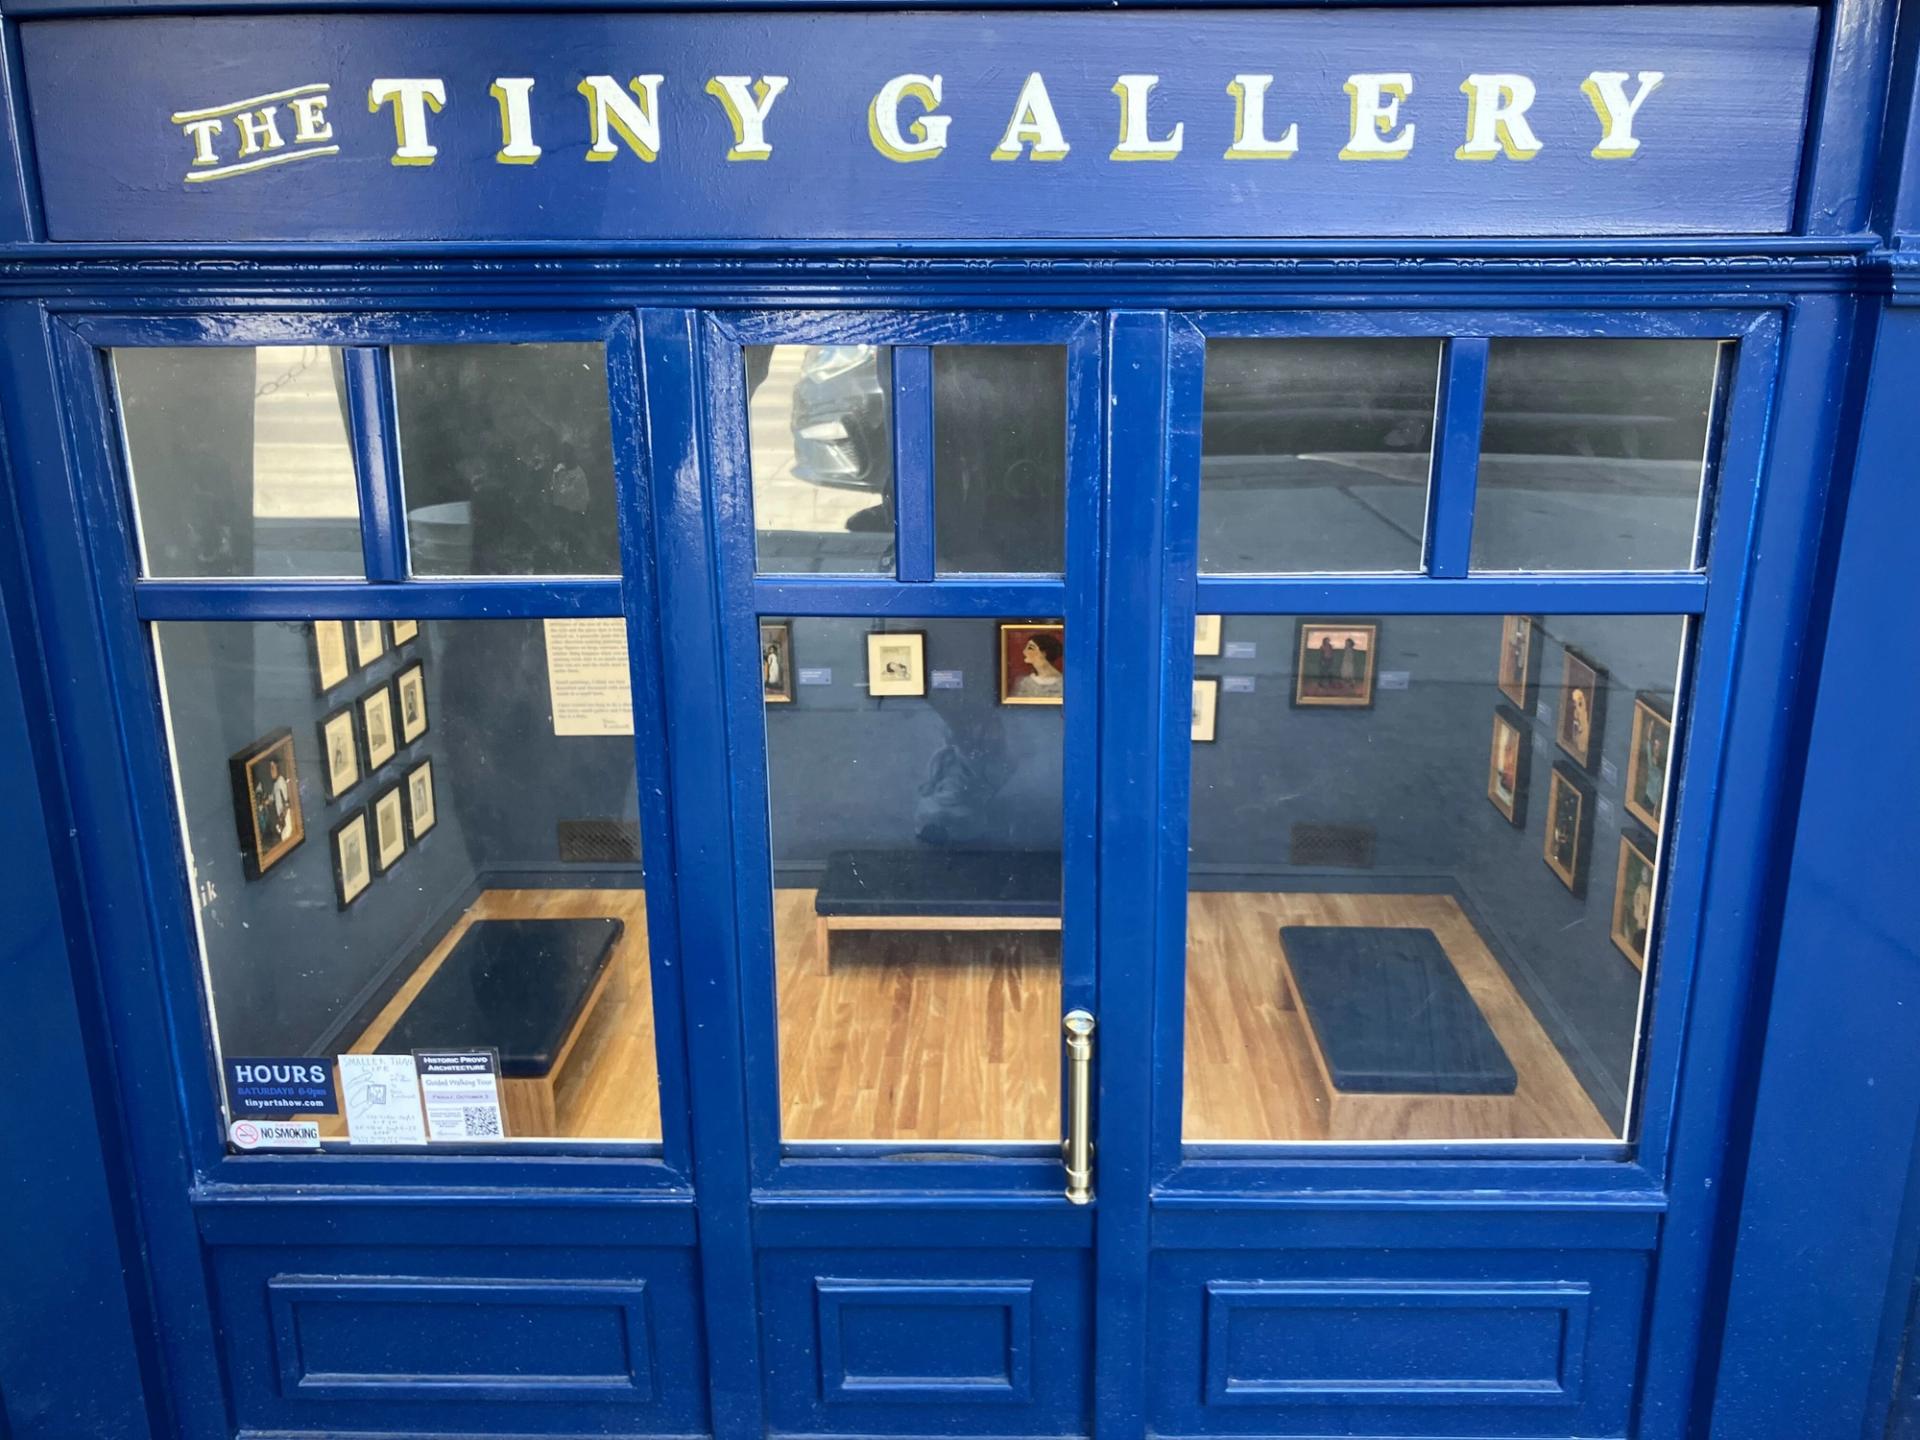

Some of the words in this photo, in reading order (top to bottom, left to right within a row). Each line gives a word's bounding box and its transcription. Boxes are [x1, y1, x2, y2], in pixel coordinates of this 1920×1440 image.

[184, 95, 333, 166] THE
[368, 73, 789, 167] TINY
[868, 70, 1665, 163] GALLERY
[423, 1056, 459, 1064] HISTORIC
[235, 1064, 326, 1084] HOURS
[425, 1078, 448, 1086] Guided
[448, 1078, 475, 1087] Walking
[238, 1087, 295, 1096] SATURDAYS
[244, 1098, 324, 1109] tinyartshow.com
[260, 1127, 274, 1139] NO
[275, 1127, 318, 1140] SMOKING
